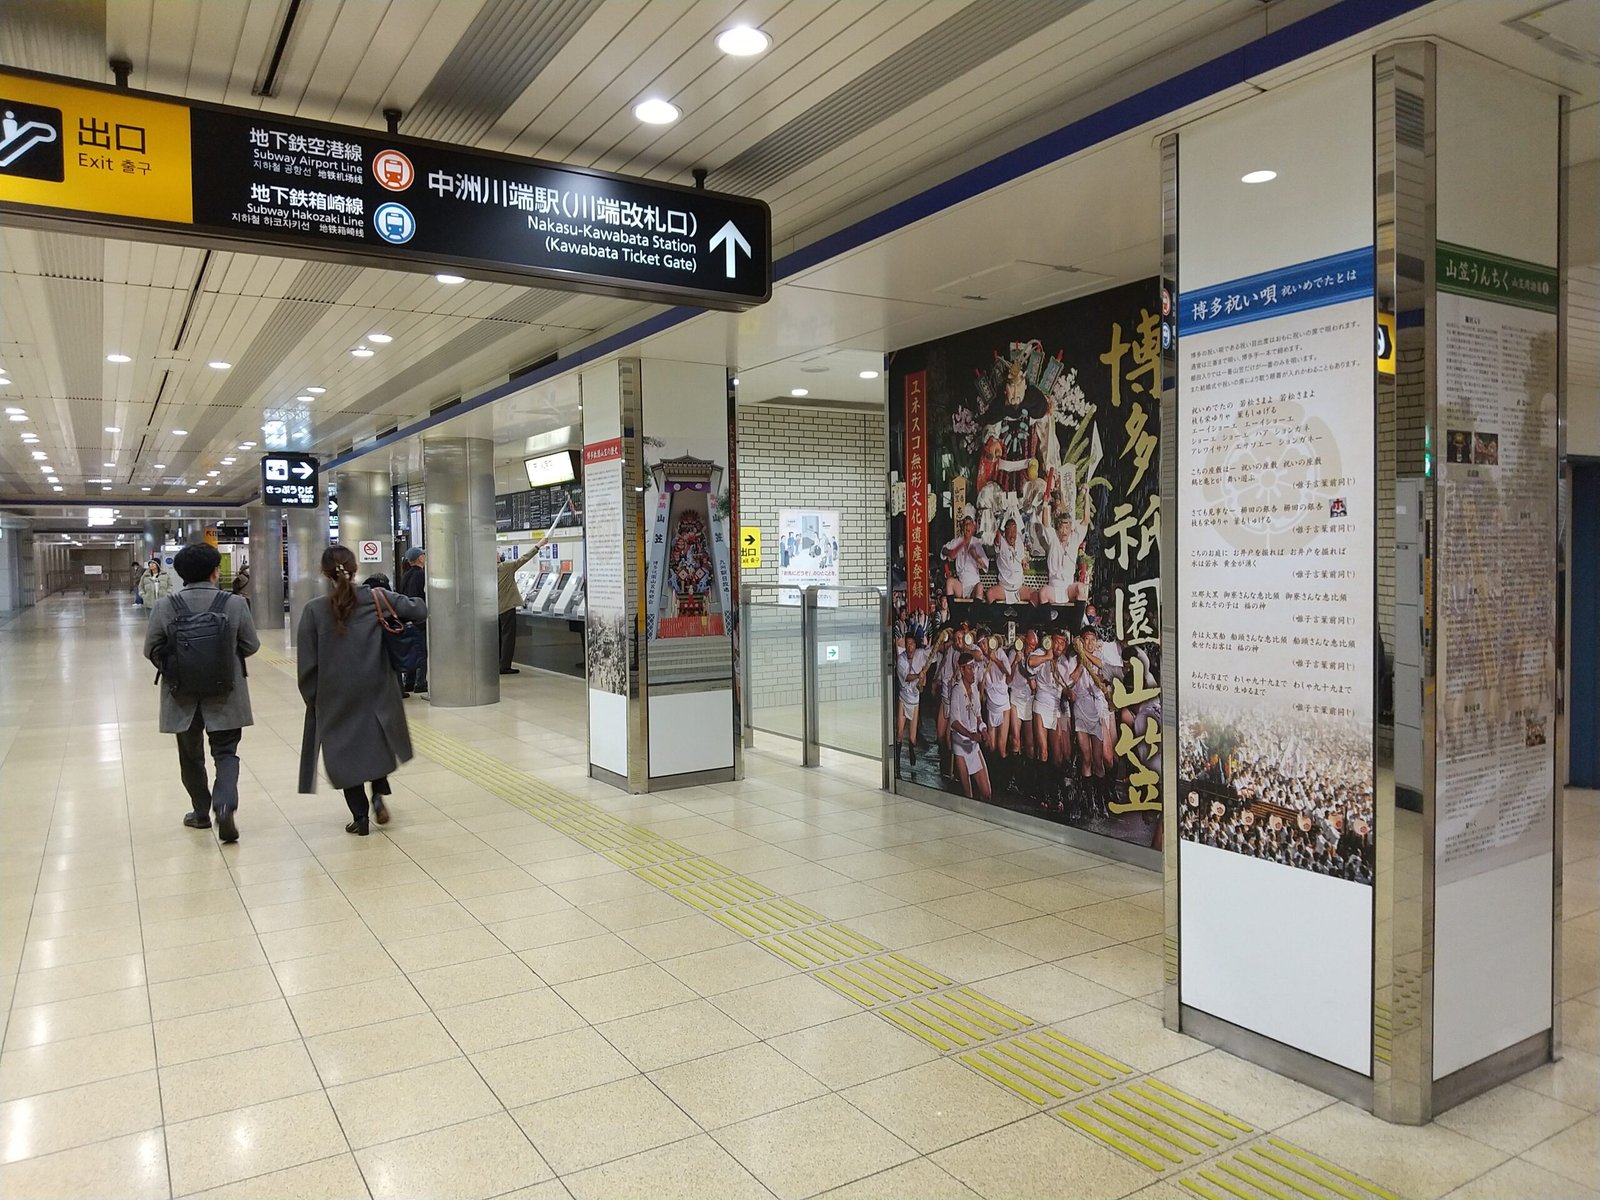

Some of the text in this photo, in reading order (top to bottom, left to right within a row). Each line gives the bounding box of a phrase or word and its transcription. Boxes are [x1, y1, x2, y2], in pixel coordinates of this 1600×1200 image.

[78, 117, 147, 155] 出口
[249, 127, 363, 162] 地下鉄空港線
[78, 153, 152, 176] Exit 출구
[253, 148, 363, 174] Subway Airport Line
[253, 160, 281, 172] 지하철
[284, 164, 312, 177] 공항선
[247, 203, 364, 227] Subway Hakozaki Line
[250, 183, 364, 216] 地下鉄箱崎線
[231, 212, 260, 225] 지하철
[263, 216, 310, 231] 하코자키선
[528, 215, 697, 254] Nakasu-Kawabata Station
[545, 235, 697, 273] (Kawabata Ticket Gate)
[1446, 258, 1509, 292] 山笠うんちく
[1191, 284, 1278, 321] 博多祝い唄
[1280, 269, 1357, 298] 祝いめでたとは
[265, 485, 314, 494] きっぷうりば
[910, 379, 923, 599] ユネスコ無形文化遺産登録
[741, 547, 756, 557] 出口
[1099, 307, 1162, 815] 博多祇園山笠
